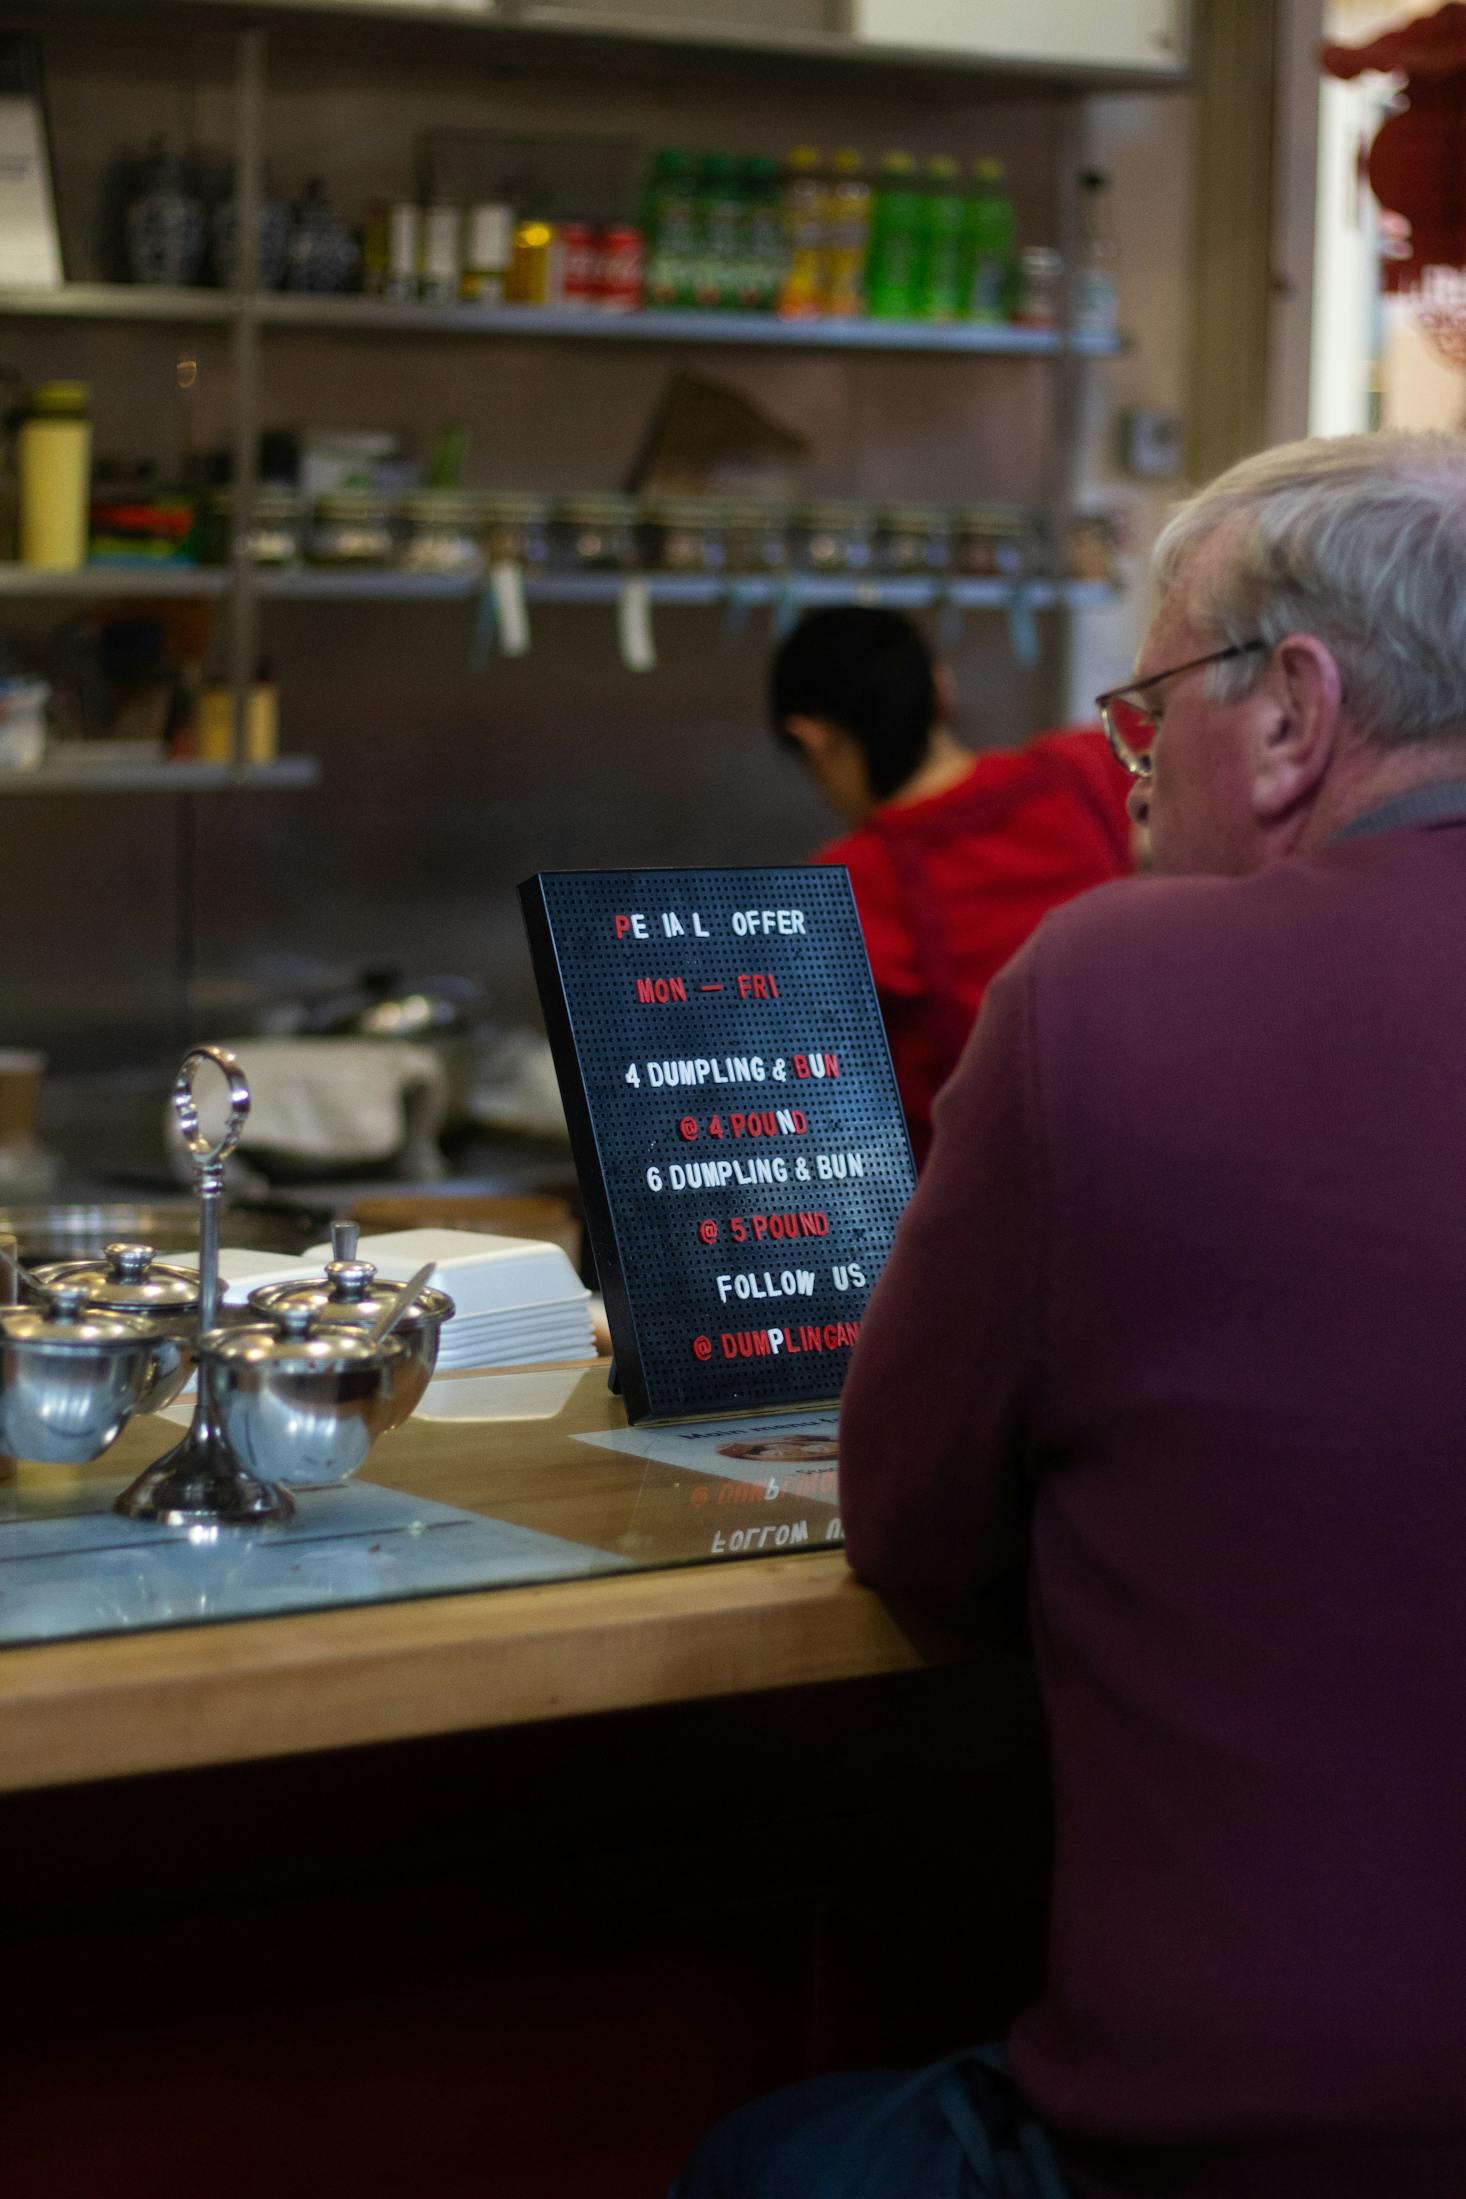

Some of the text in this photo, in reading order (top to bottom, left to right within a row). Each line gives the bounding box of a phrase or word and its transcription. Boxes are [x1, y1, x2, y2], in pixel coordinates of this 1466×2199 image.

[732, 909, 807, 936] OFFER
[636, 976, 688, 1004] MON
[737, 973, 779, 999] FRI
[625, 1053, 840, 1088] 4 DUMPLING & BUN
[679, 1109, 809, 1141] @ 4 POUND
[646, 1152, 865, 1192] 6 DUMPLING & BUN
[699, 1211, 830, 1245] @ 5 POUND
[716, 1262, 866, 1304] FOLLOW US
[693, 1334, 712, 1361] @
